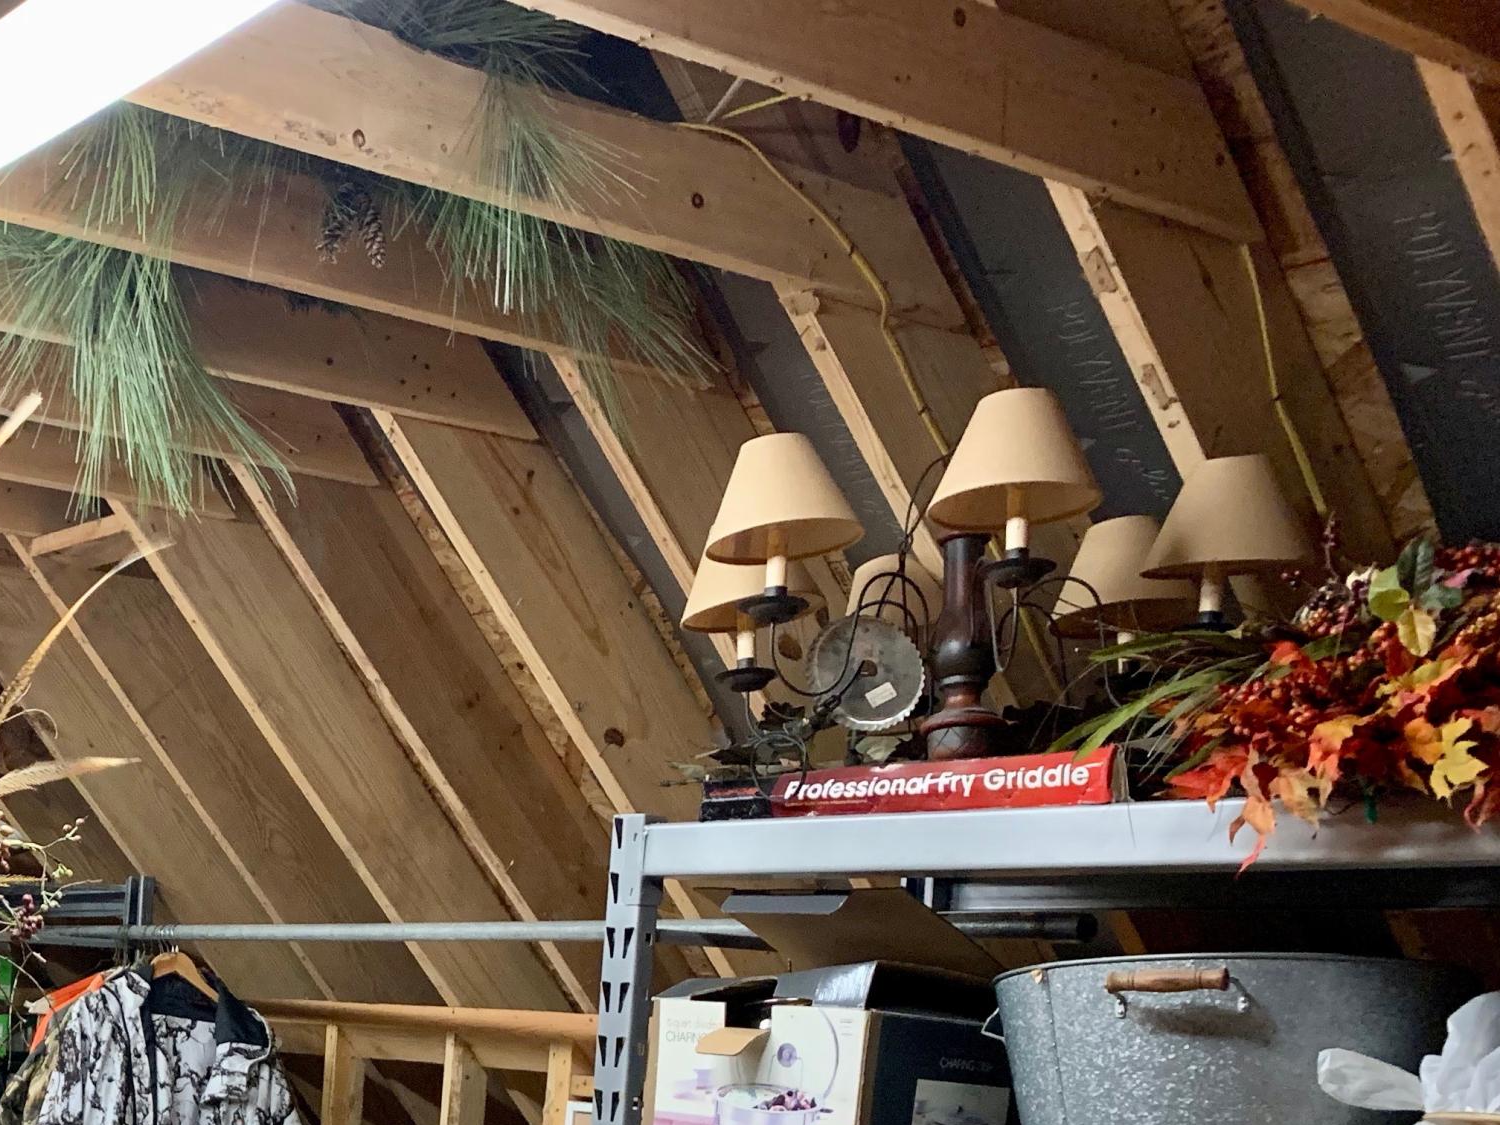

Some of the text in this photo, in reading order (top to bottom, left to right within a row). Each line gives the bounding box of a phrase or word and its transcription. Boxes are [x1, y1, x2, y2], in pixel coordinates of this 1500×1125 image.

[784, 774, 932, 800] Professional
[937, 772, 974, 797] Fry
[983, 763, 1089, 790] Griddle
